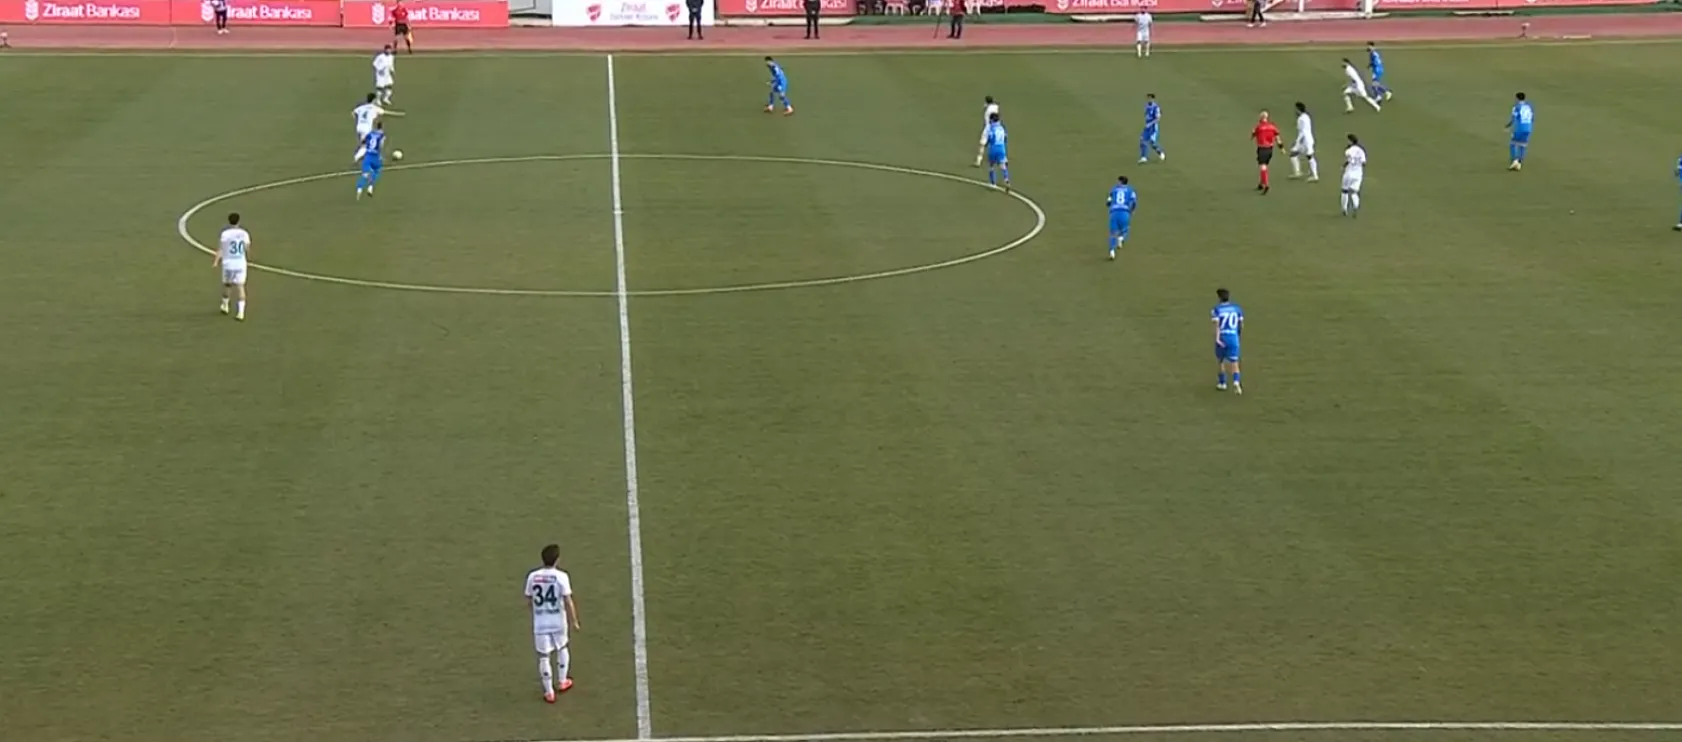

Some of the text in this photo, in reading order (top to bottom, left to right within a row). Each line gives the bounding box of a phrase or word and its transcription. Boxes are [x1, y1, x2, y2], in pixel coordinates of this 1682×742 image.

[43, 2, 140, 18] Ziraat Bankası
[226, 5, 312, 19] iraat Bankası
[429, 7, 480, 21] Bankası
[1116, 190, 1125, 204] 8
[1219, 312, 1238, 328] 70
[532, 584, 557, 606] 34
